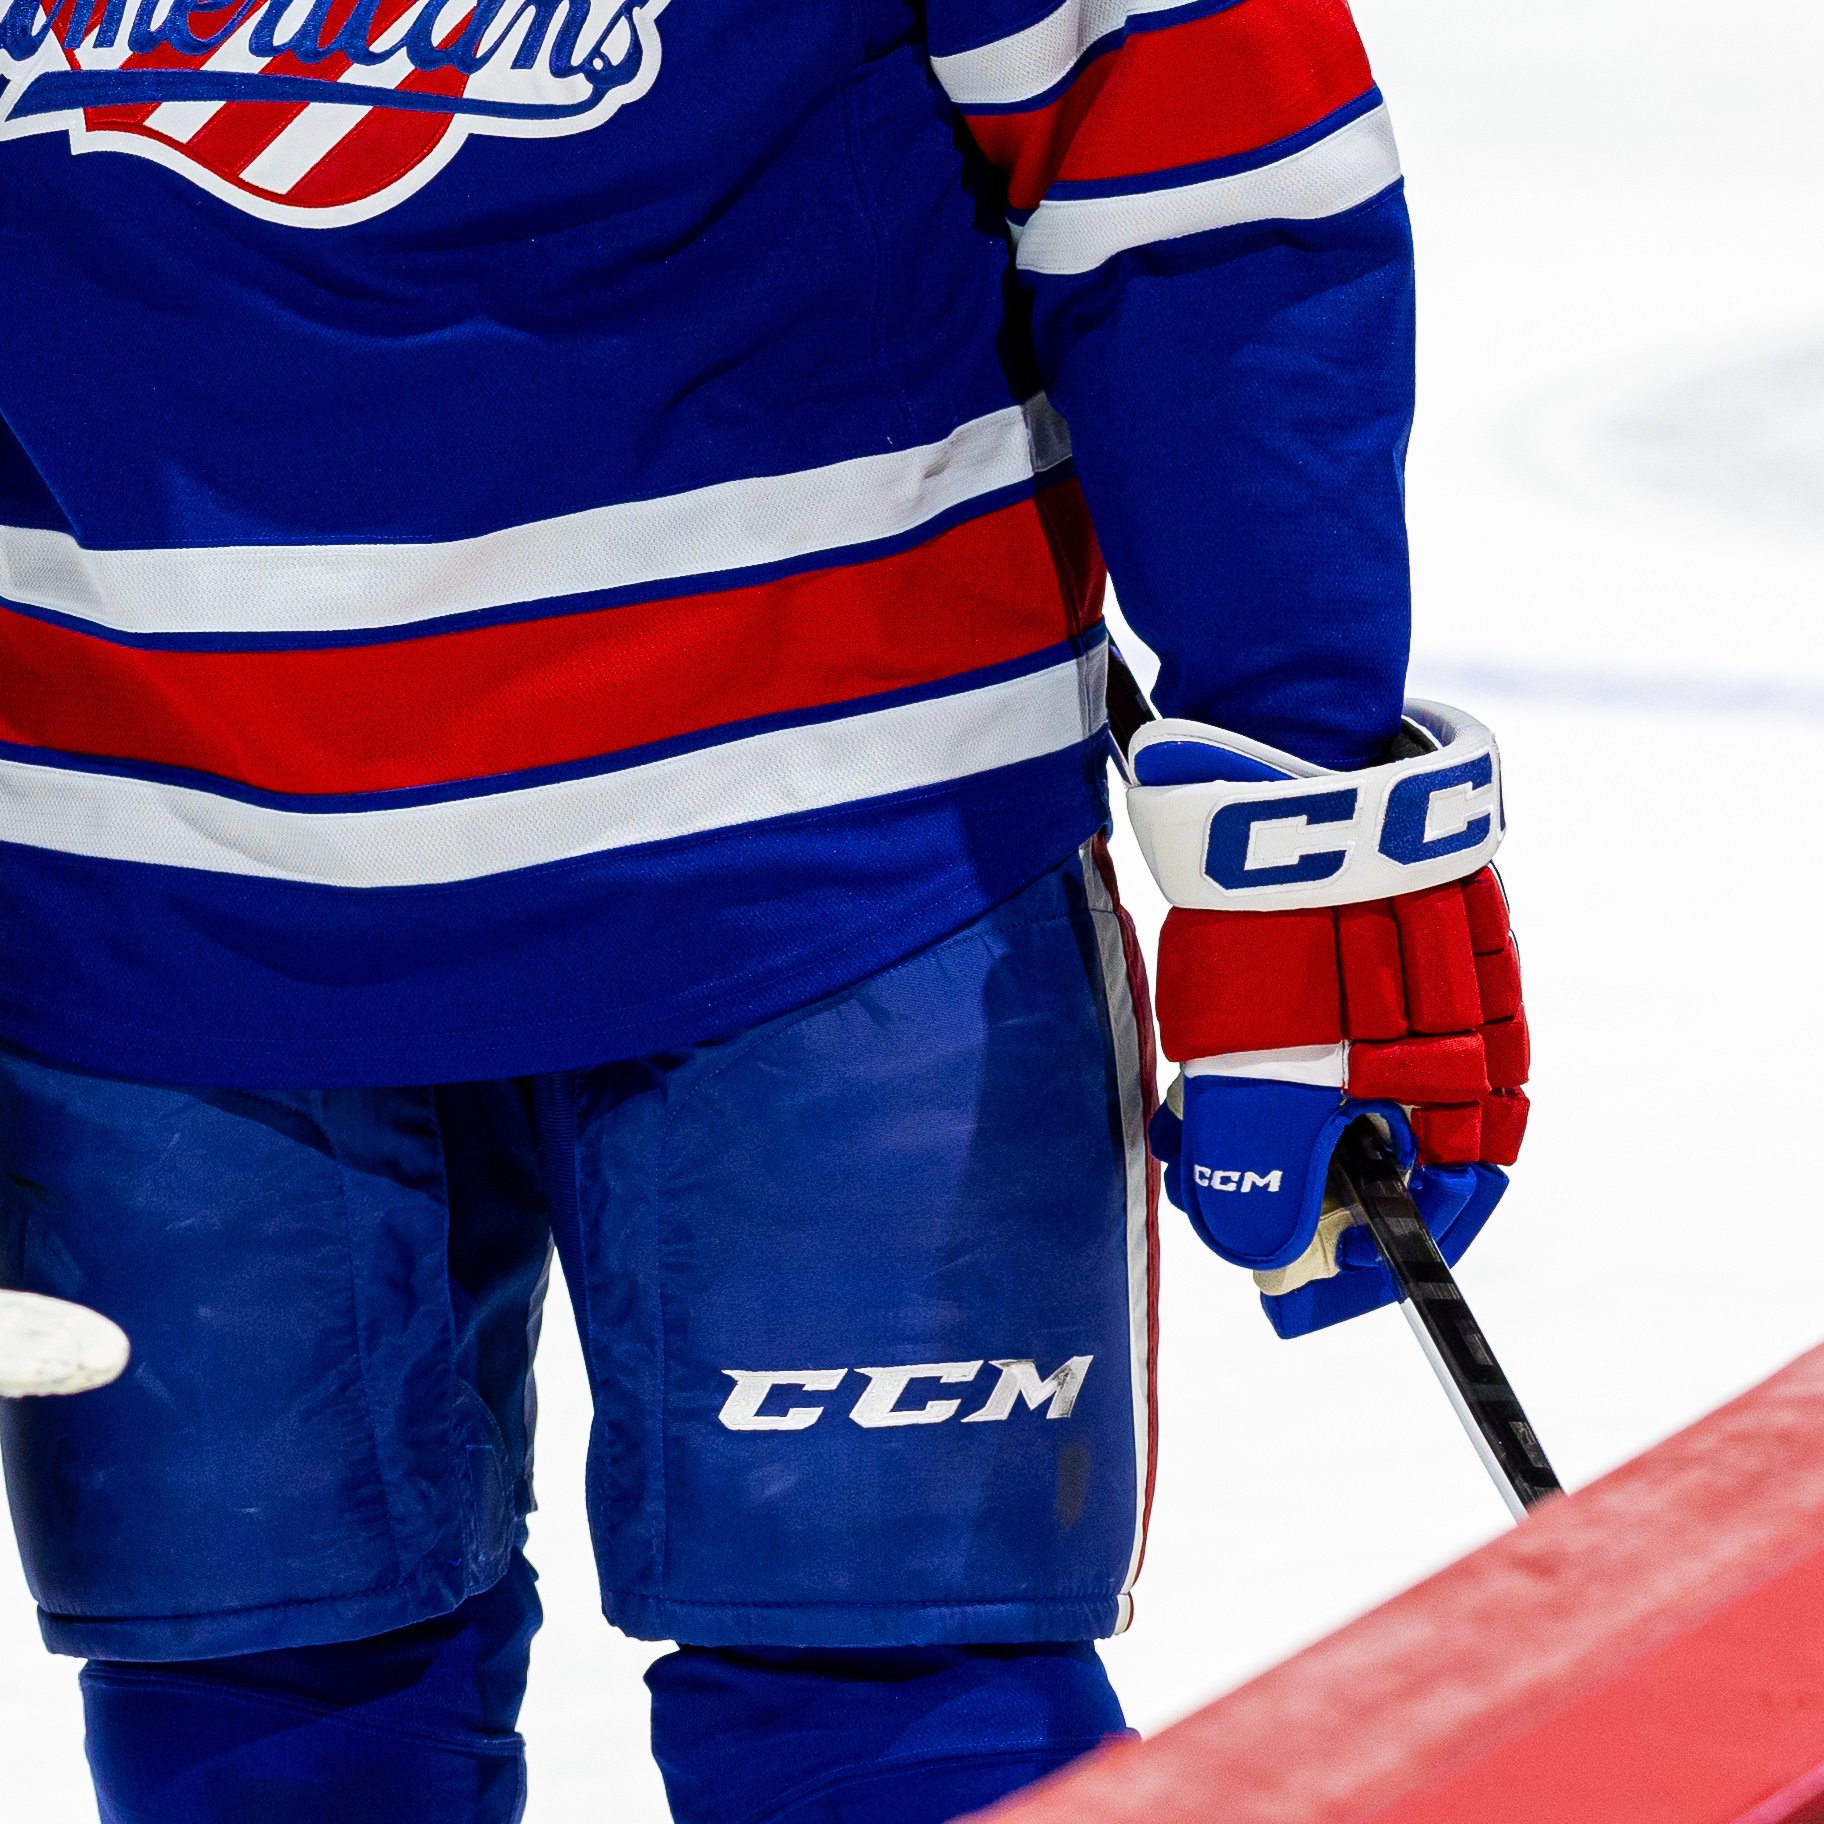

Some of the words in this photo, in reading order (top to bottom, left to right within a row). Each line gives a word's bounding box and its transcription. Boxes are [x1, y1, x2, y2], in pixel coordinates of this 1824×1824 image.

[1204, 750, 1507, 892] CC
[1193, 1163, 1284, 1194] CCM
[716, 1354, 1095, 1432] CCM
